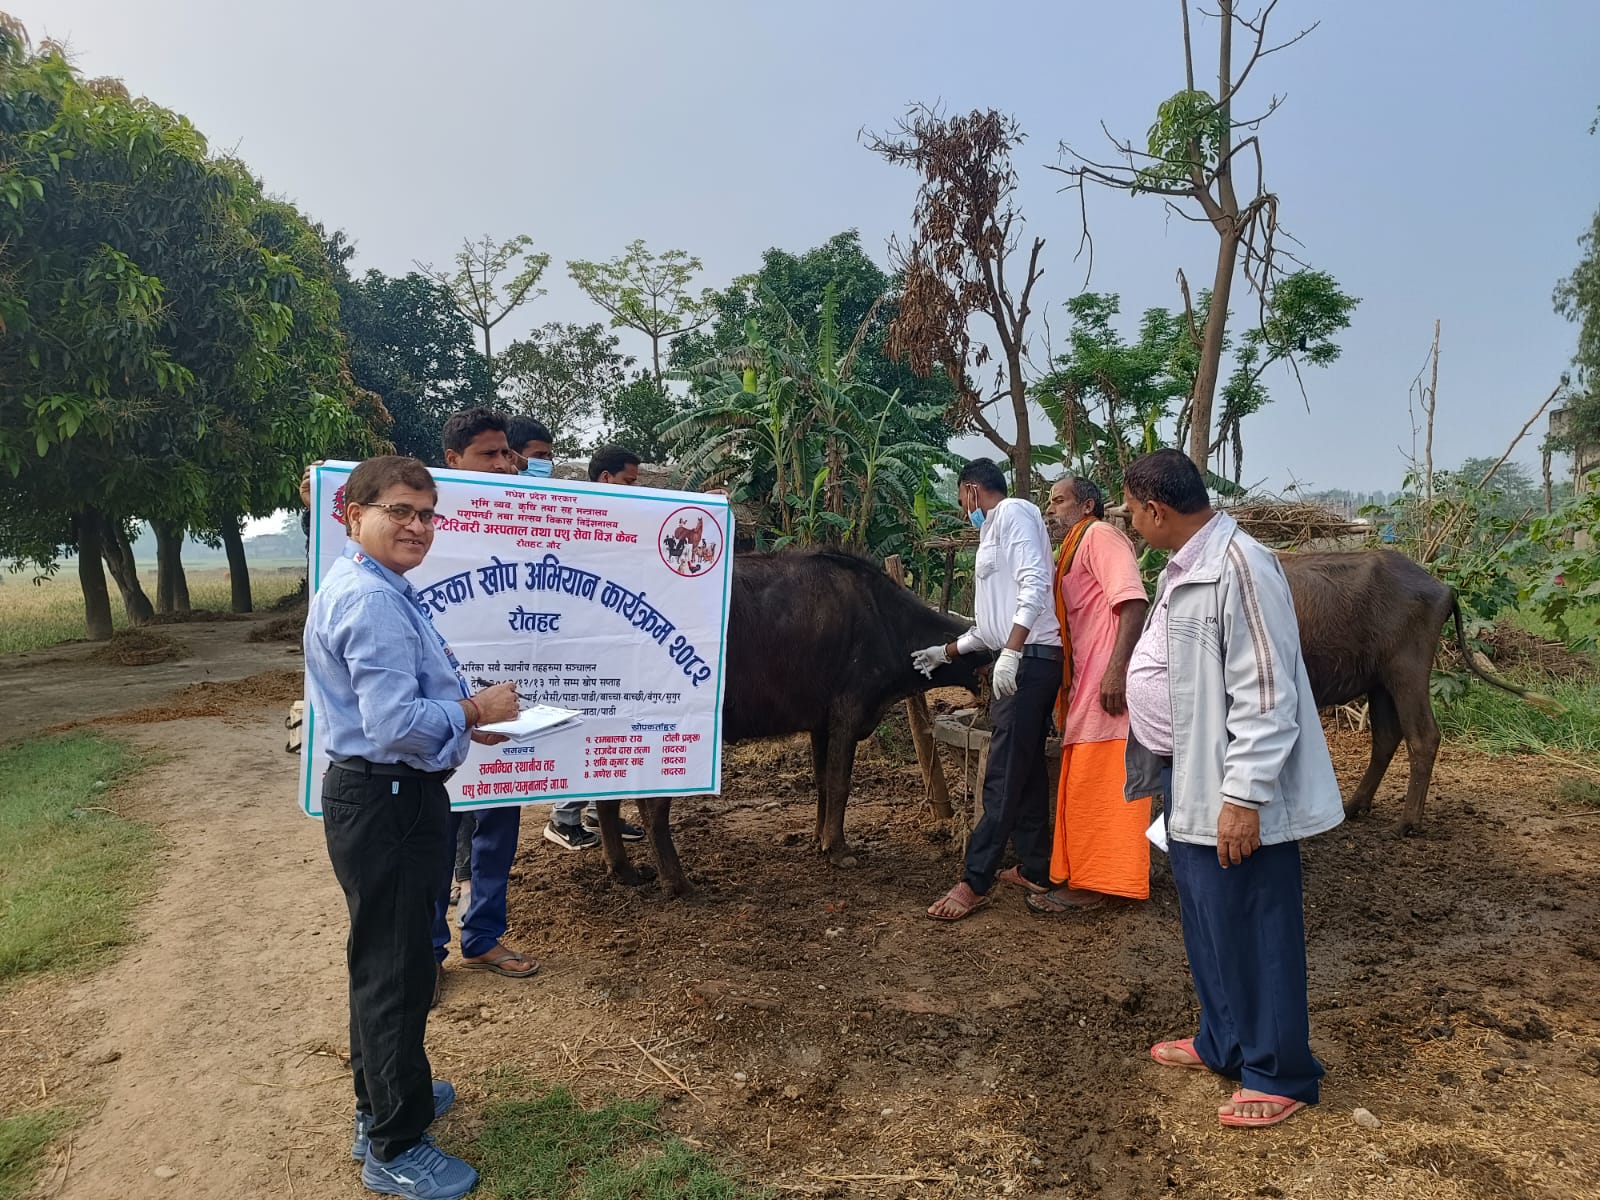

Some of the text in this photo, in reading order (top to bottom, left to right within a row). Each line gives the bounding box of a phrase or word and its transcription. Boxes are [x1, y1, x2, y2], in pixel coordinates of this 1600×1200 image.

[529, 492, 547, 501] प्रदेश
[483, 523, 528, 536] अस्पताल
[531, 526, 551, 538] तथा
[554, 528, 571, 541] पशु
[573, 527, 592, 541] सेवा
[477, 555, 518, 596] खोप
[525, 553, 601, 601] अभियान
[600, 580, 676, 646] कार्यक्रम
[668, 635, 712, 687] २०८२
[508, 604, 562, 633] रौतहट
[582, 676, 597, 687] खोप
